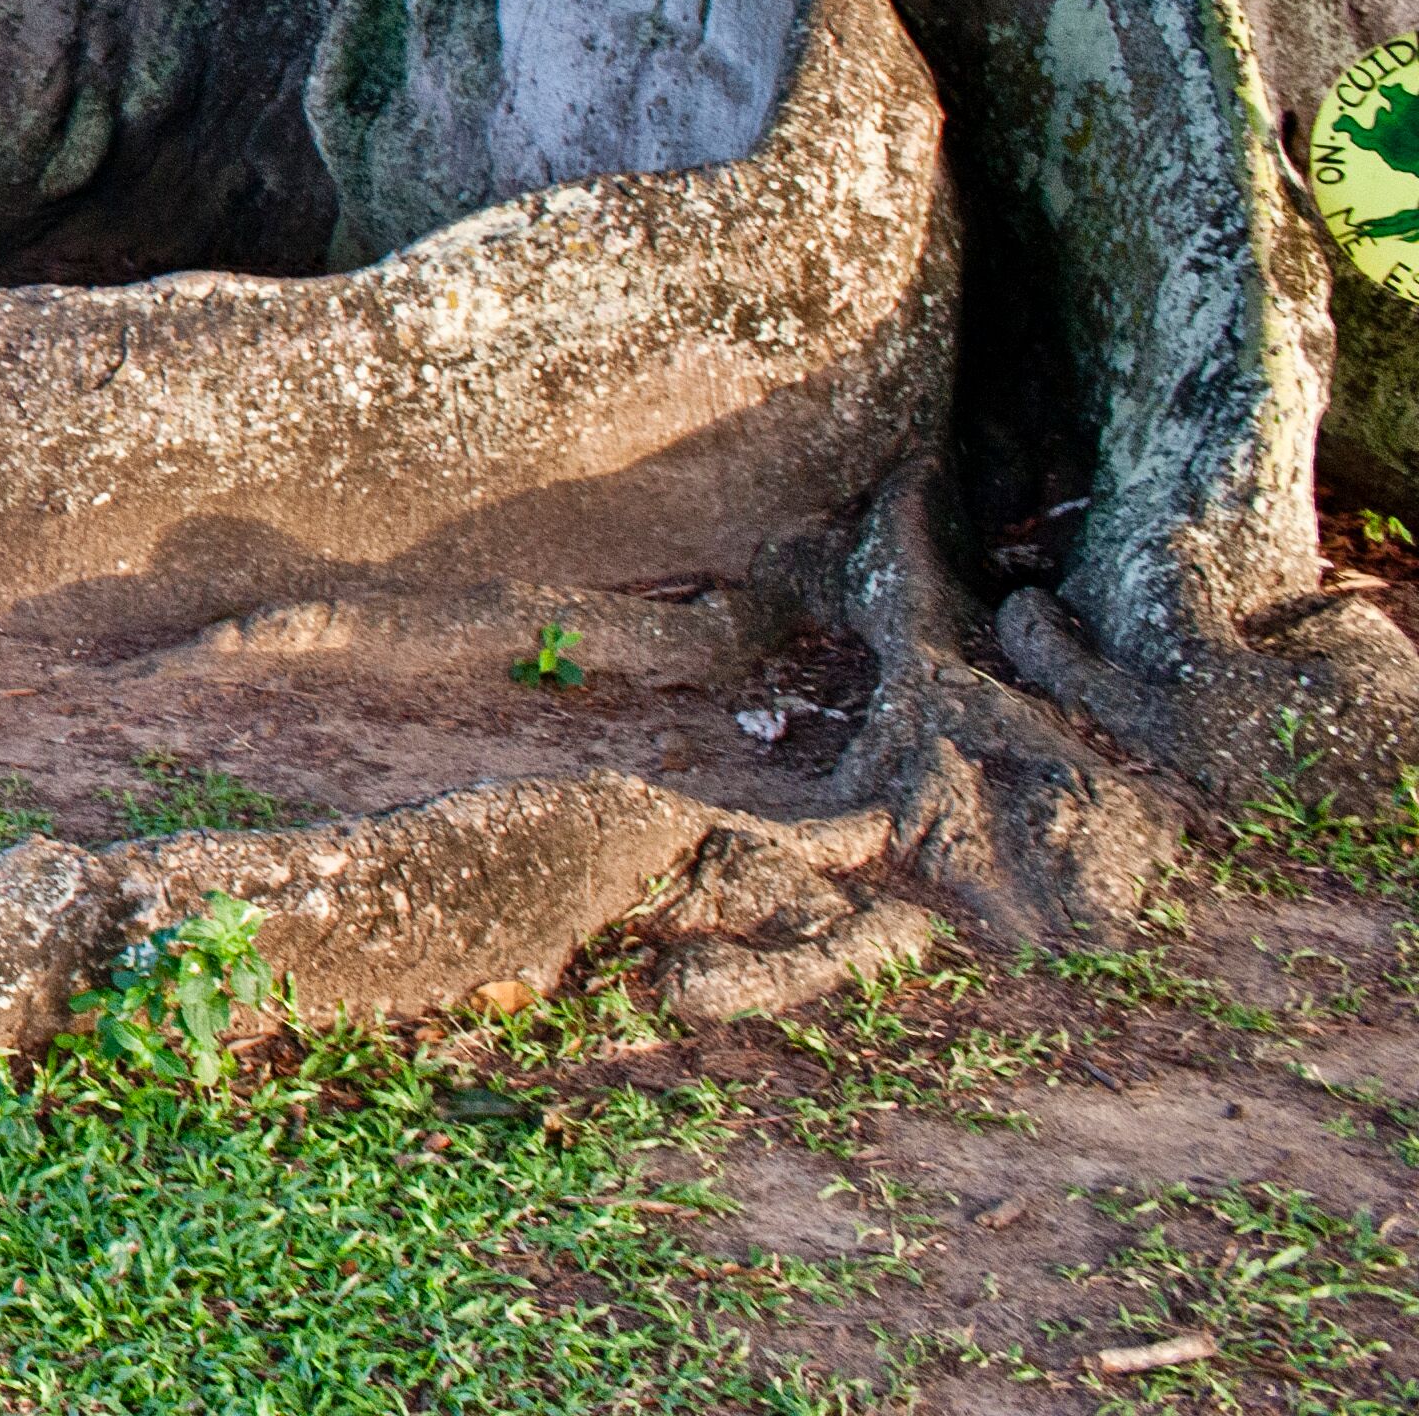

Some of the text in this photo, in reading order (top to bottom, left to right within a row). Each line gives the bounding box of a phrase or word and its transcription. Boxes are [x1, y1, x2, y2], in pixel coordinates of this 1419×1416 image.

[1337, 33, 1419, 107] CUID
[1312, 143, 1346, 184] NO
[1324, 207, 1377, 257] ME
